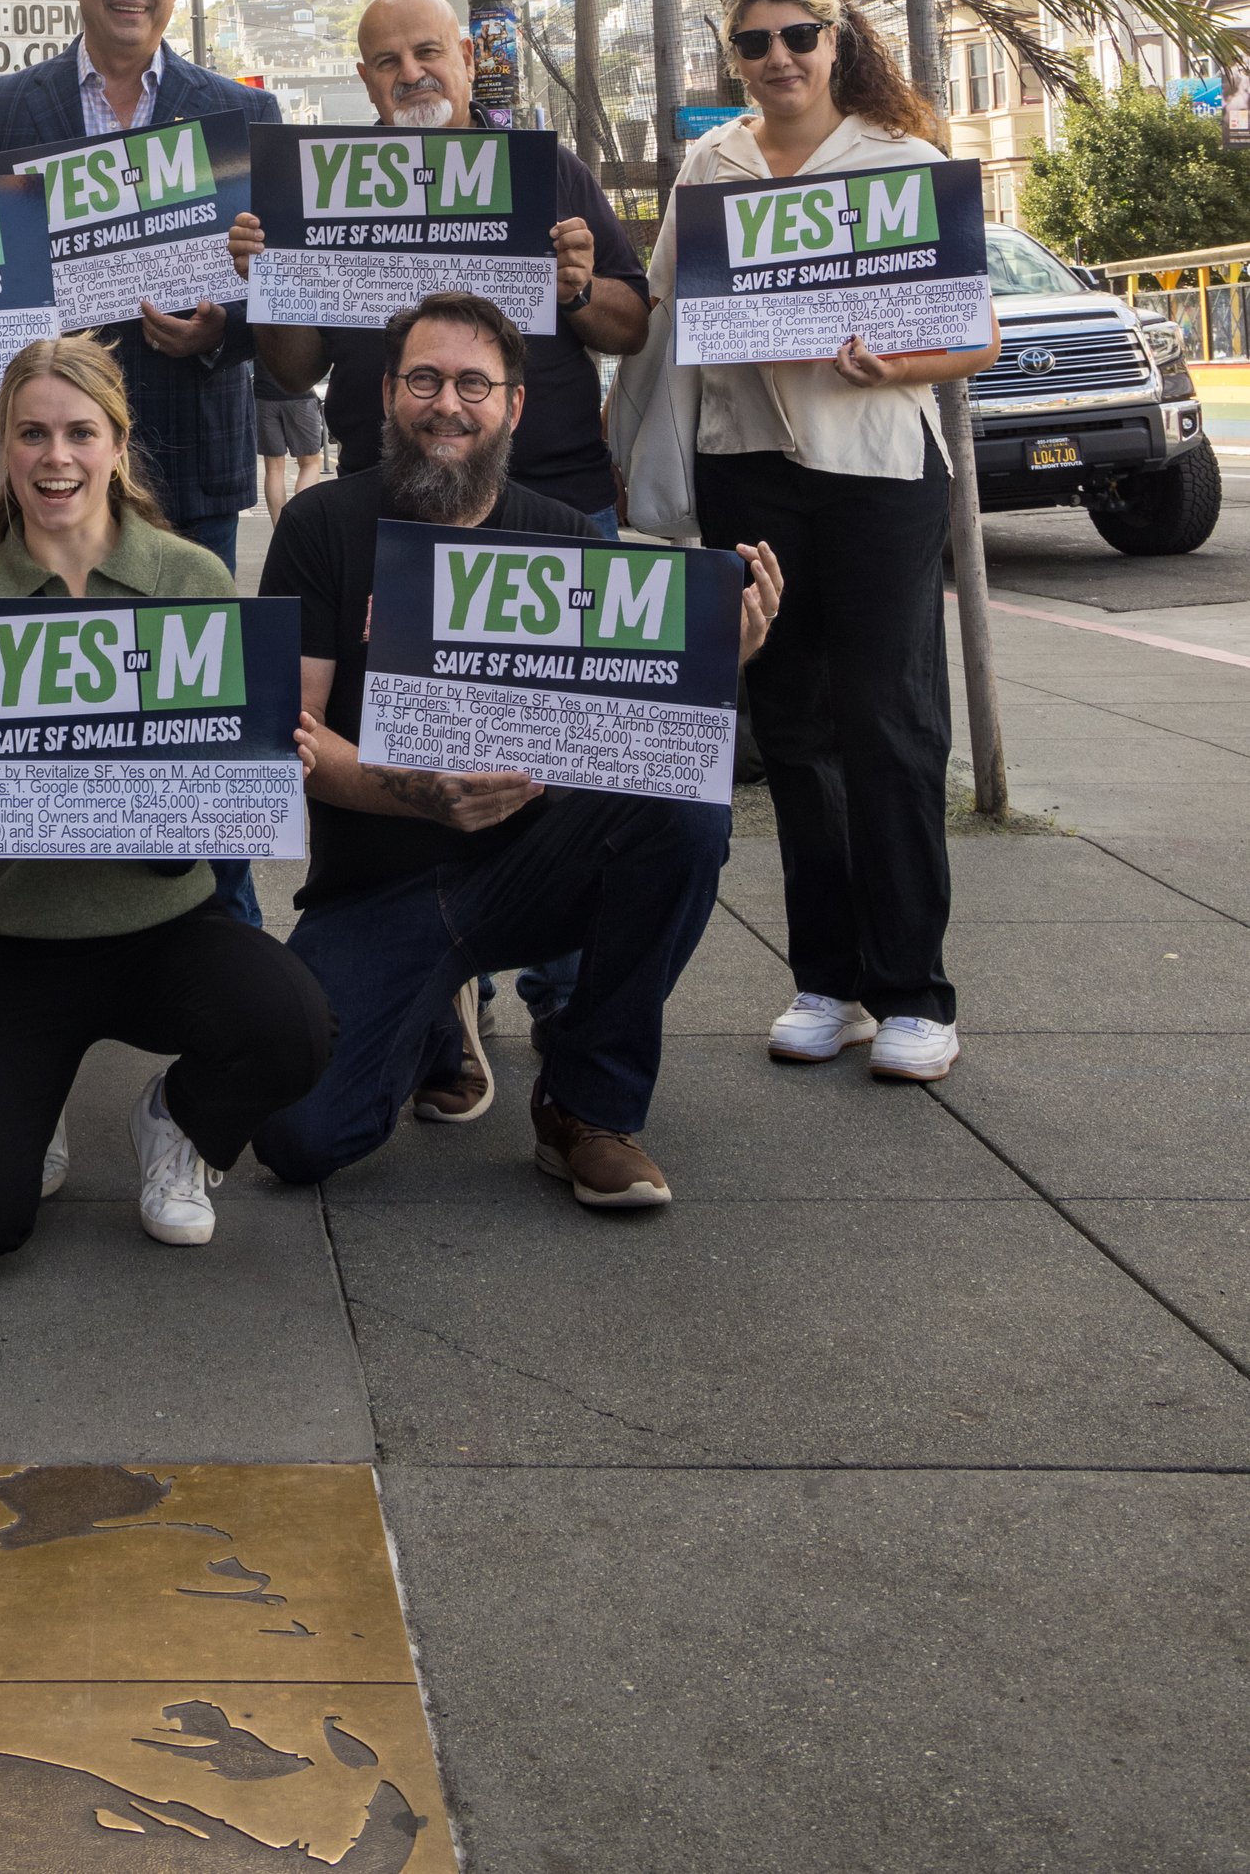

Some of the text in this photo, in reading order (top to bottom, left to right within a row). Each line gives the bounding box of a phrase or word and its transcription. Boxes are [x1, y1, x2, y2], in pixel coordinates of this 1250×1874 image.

[124, 168, 139, 182] ON
[147, 128, 196, 200] M
[313, 139, 498, 208] YES ON M
[72, 231, 90, 252] SF
[92, 220, 141, 247] SMALL
[144, 202, 217, 235] BUSINESS
[304, 221, 507, 245] SAVE SF SMALL BUSINESS
[733, 175, 924, 258] YES ON M
[730, 249, 937, 292] SAVE SF SMALL BUSINESS
[449, 551, 565, 634] YES
[571, 590, 592, 606] ON
[598, 558, 672, 639] M
[127, 652, 147, 669] ON
[156, 611, 227, 698] M
[432, 650, 678, 684] SAVE SF SMALL BUSINESS
[43, 725, 68, 751] SF
[71, 722, 136, 749] SMALL
[141, 715, 241, 745] BUSINESS
[5, 764, 20, 783] by
[25, 764, 89, 778] Revitalize
[119, 764, 144, 778] Yes
[148, 768, 166, 778] on
[170, 764, 187, 778] M.
[191, 764, 209, 778] Ad
[214, 764, 296, 779] Committee's
